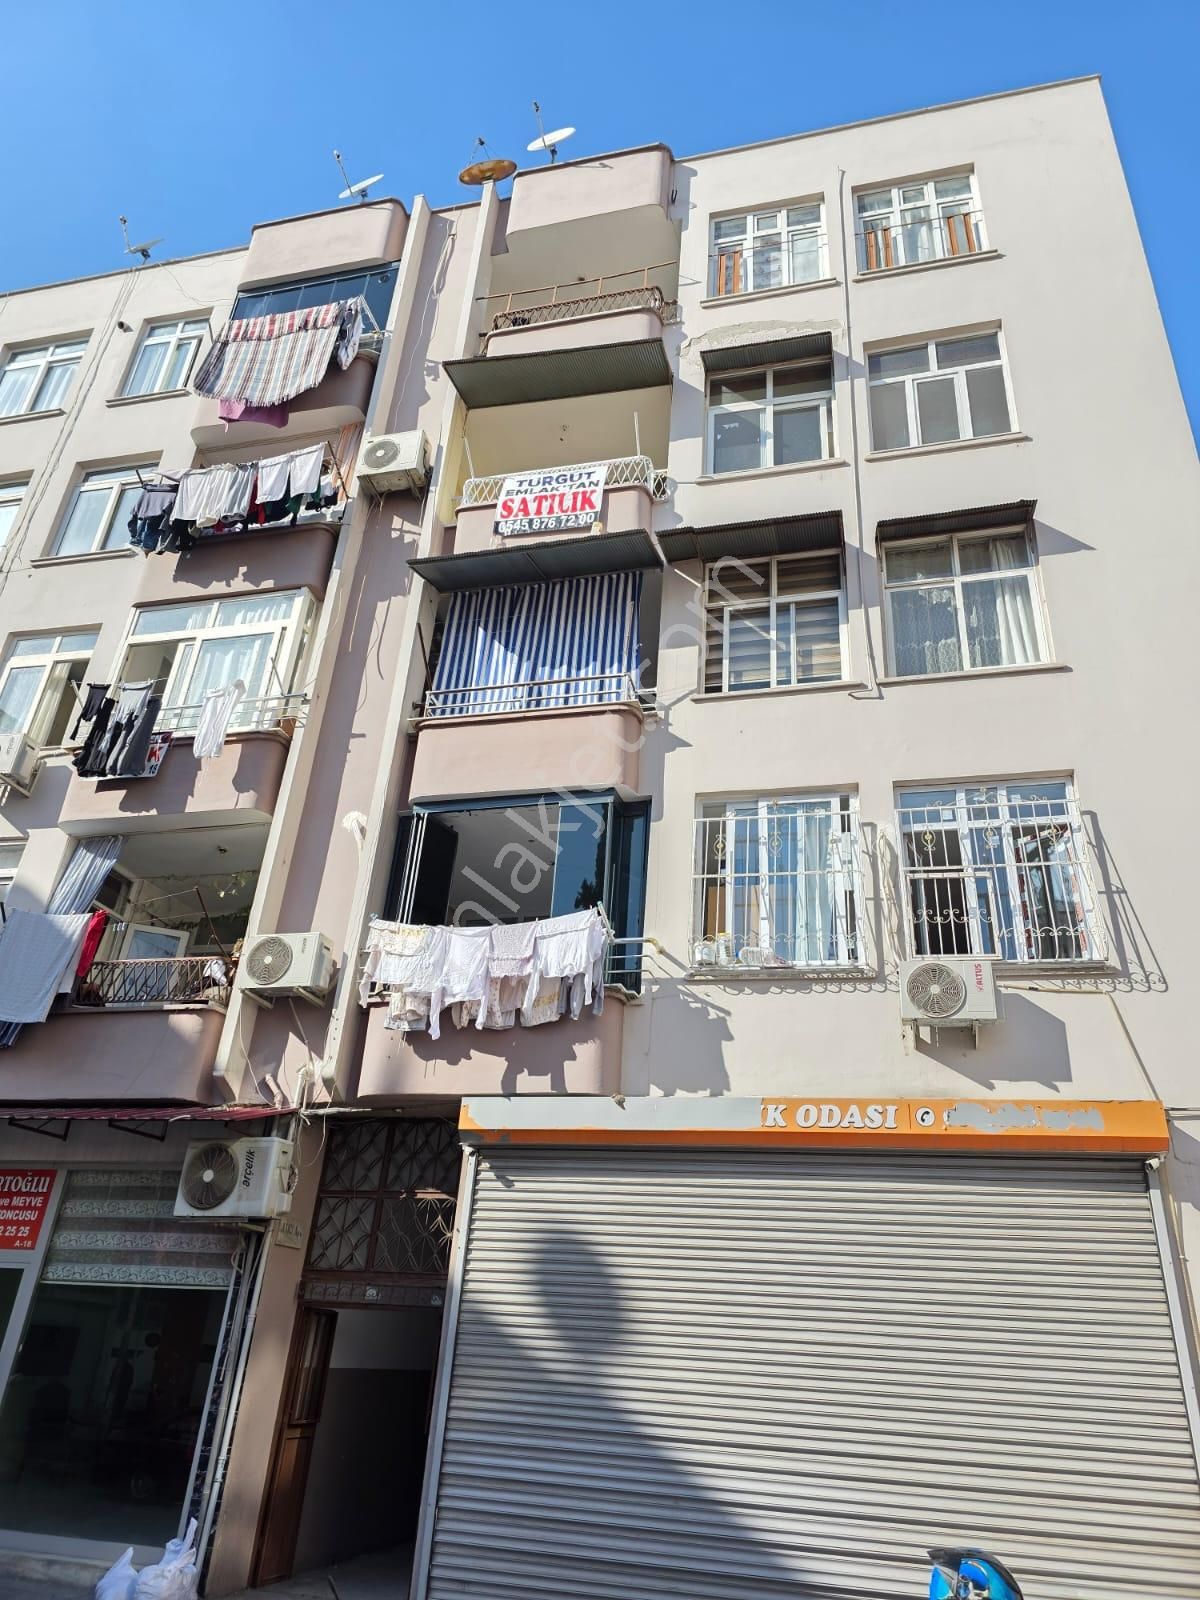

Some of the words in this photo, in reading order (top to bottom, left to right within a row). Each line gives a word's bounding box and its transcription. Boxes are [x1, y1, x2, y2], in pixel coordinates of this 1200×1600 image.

[516, 471, 597, 488] TURGUT
[500, 489, 598, 519] SATILIK
[532, 517, 556, 529] 876
[560, 515, 576, 527] 72
[760, 1104, 788, 1127] K
[796, 1104, 899, 1128] ODASI
[242, 1148, 256, 1187] arçelik
[11, 1196, 44, 1207] MEYVE
[5, 1225, 17, 1237] 25
[17, 1226, 31, 1237] 25
